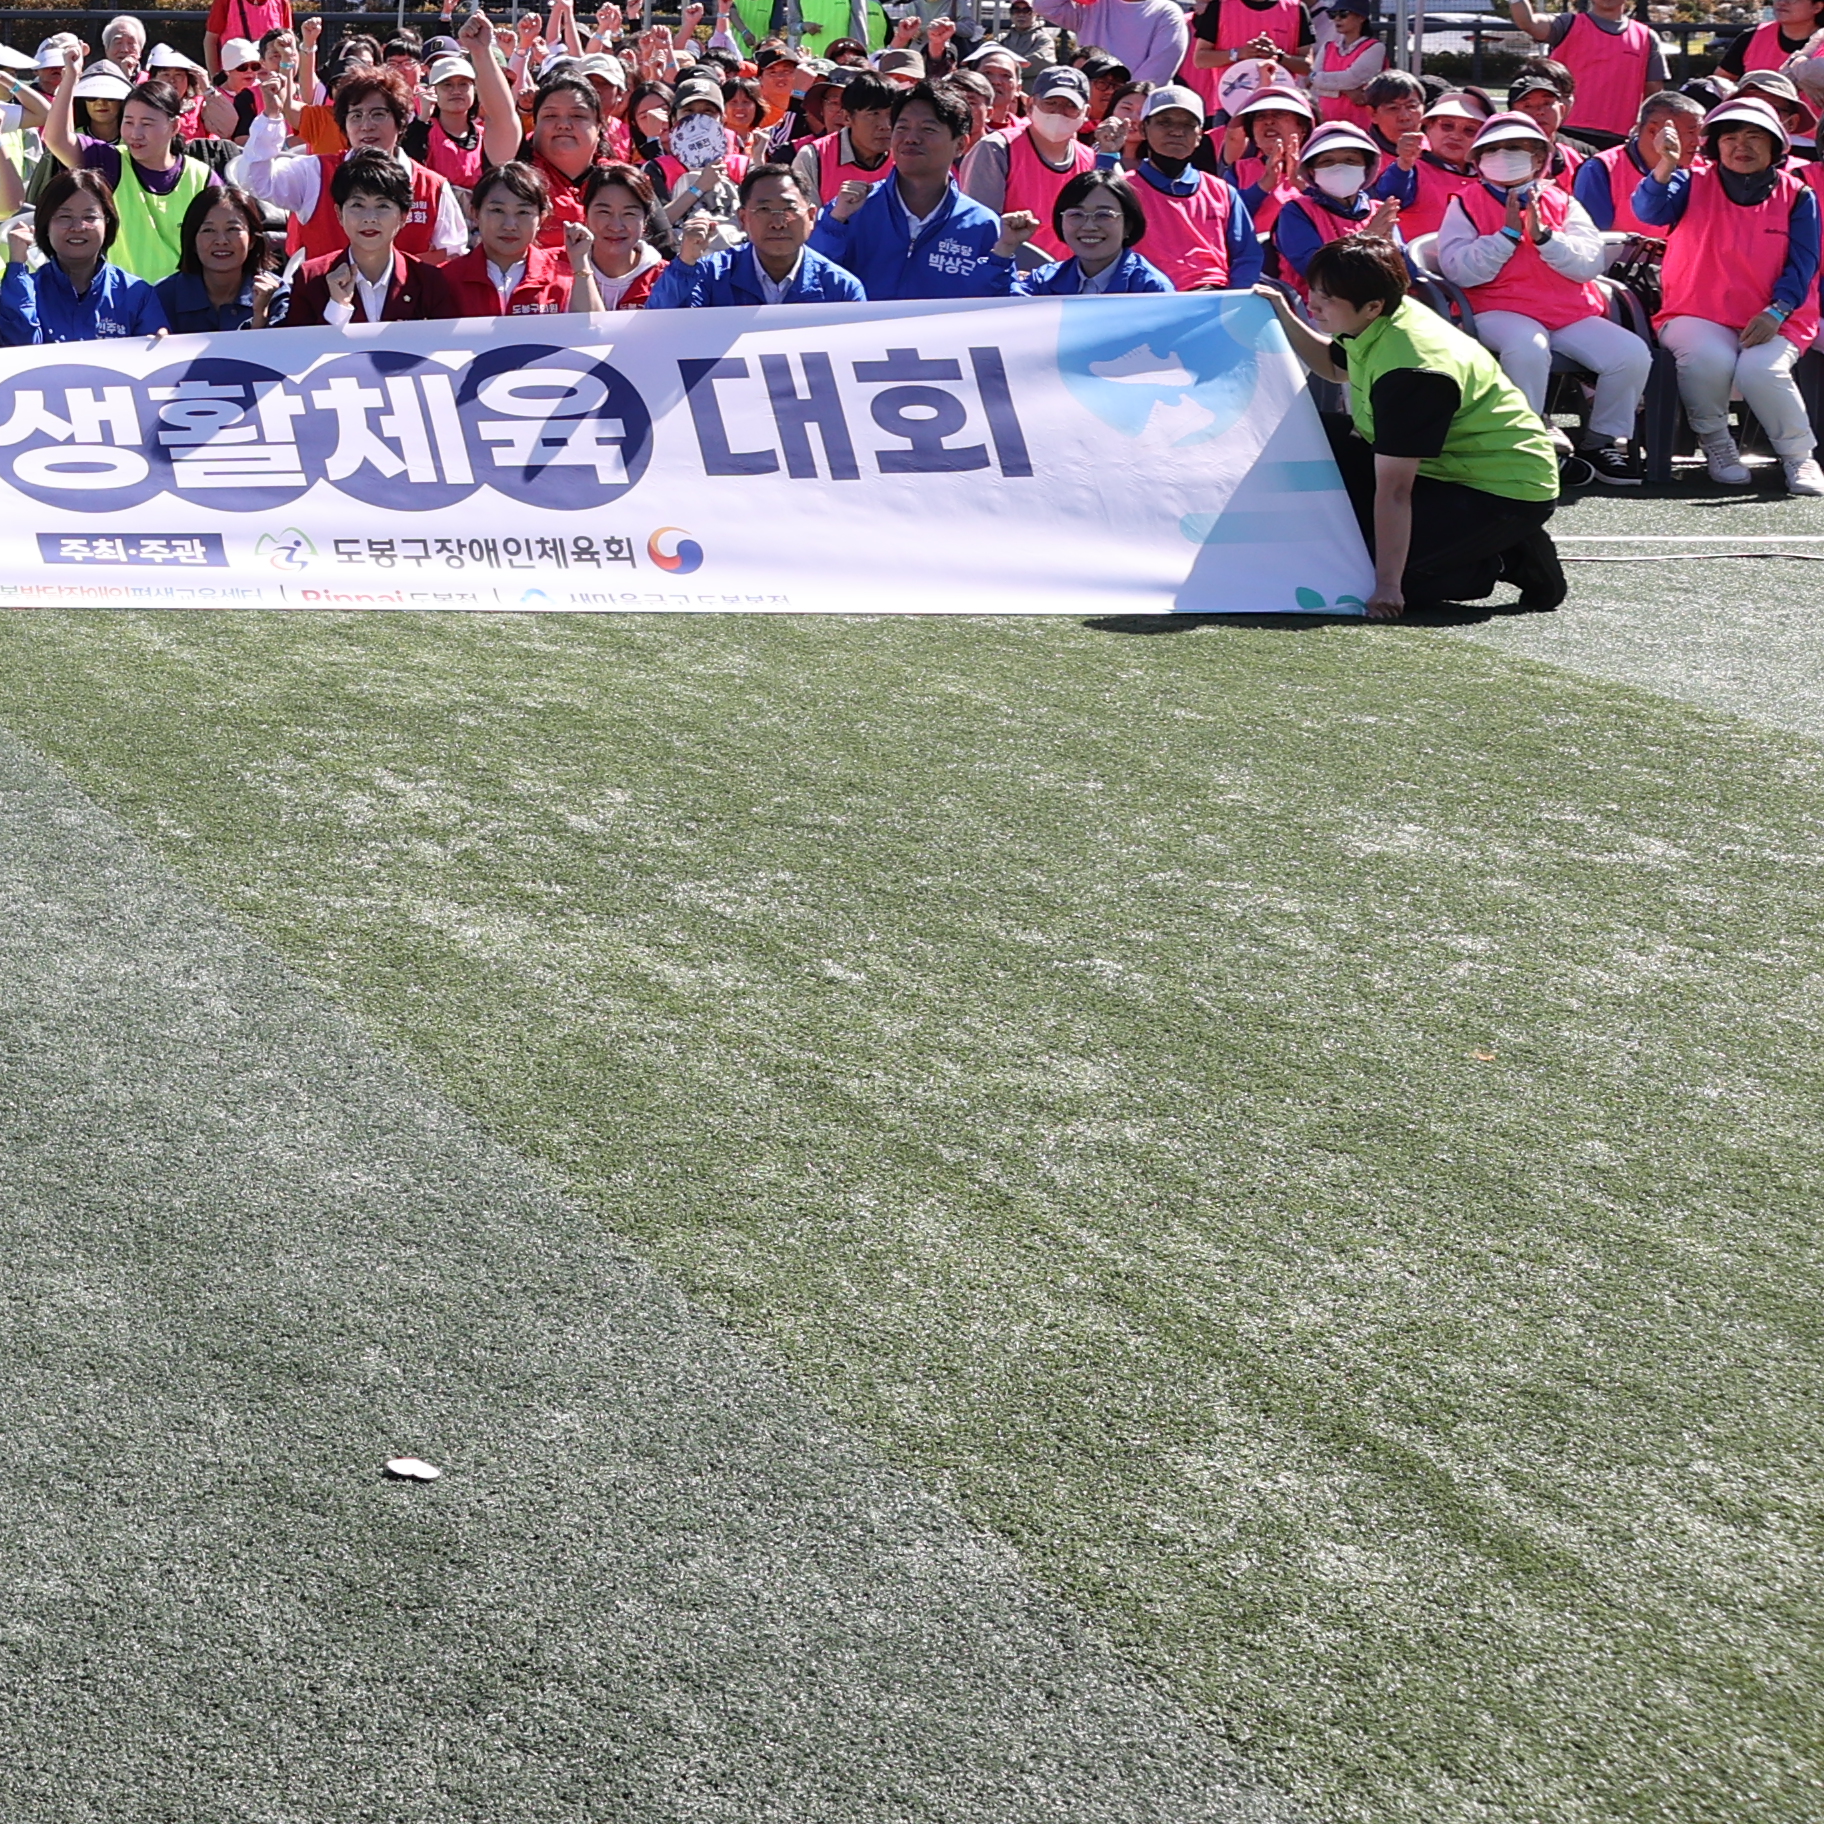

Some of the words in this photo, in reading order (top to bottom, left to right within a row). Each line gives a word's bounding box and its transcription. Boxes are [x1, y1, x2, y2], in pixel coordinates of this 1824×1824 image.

[938, 240, 973, 256] 민주당
[928, 253, 977, 277] 박상근
[512, 302, 558, 314] 도봉구의원
[676, 346, 1035, 481] 대회
[59, 538, 207, 564] 주최·주관
[333, 535, 638, 570] 도봉구장애인체육회
